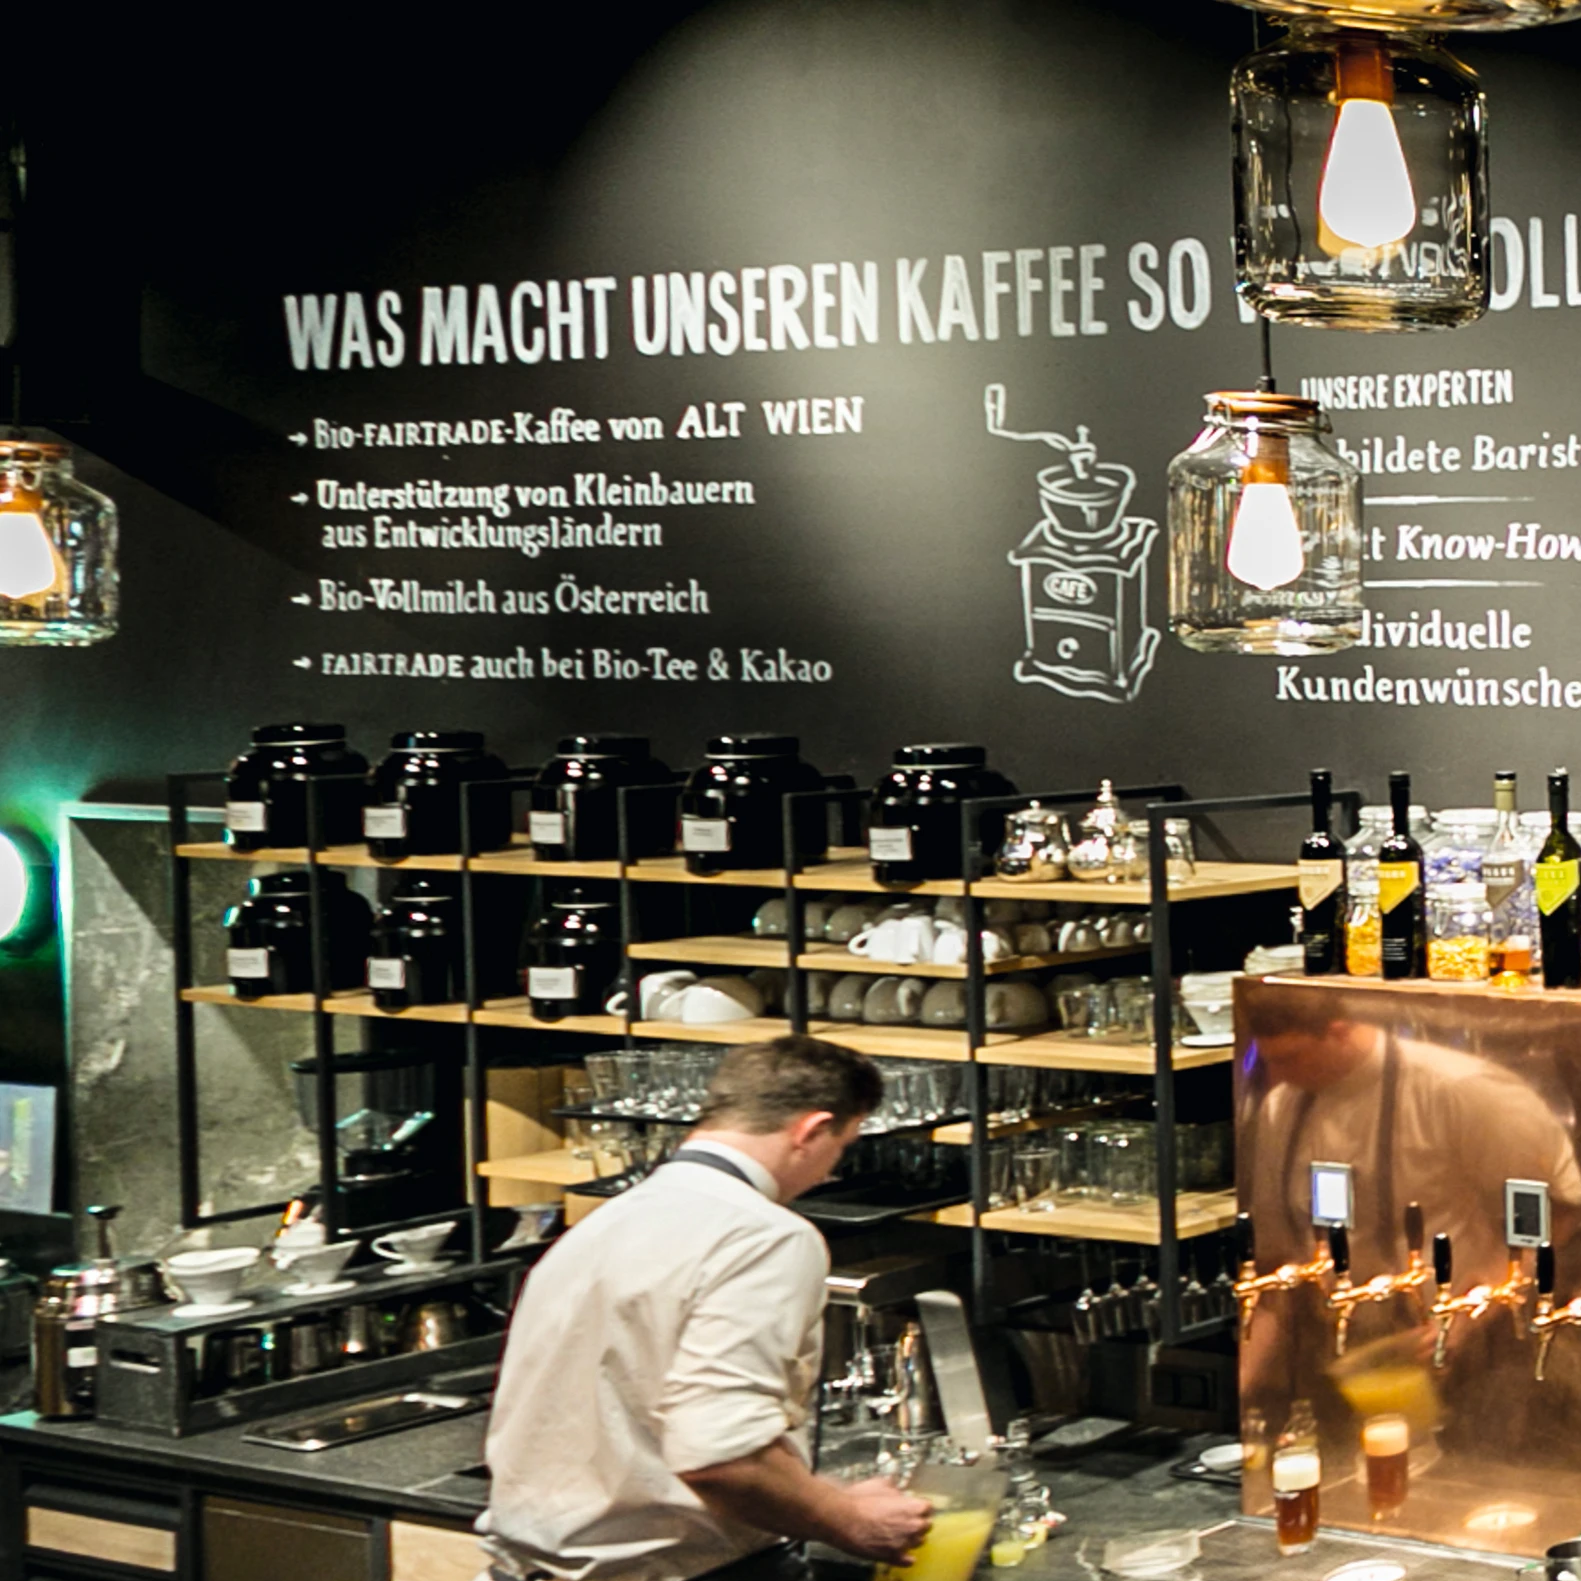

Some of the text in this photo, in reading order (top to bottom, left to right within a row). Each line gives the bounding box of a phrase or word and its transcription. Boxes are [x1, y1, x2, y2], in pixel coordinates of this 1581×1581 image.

[285, 291, 404, 369] WAS
[421, 277, 617, 365] MACHT
[632, 260, 881, 357] UNSEREN
[896, 244, 1107, 343] KAFFEE
[1128, 238, 1211, 330] SO
[1302, 369, 1513, 410] UNSERE EXPERTEN
[608, 418, 663, 440] von
[677, 402, 746, 439] ALT
[762, 396, 865, 434] WIEN
[317, 472, 755, 516] Unterstützung von Kleinbauern
[323, 512, 661, 557] aus Entwicklungsländern
[320, 574, 709, 614] Bio-Vollmilch aus Österreich
[323, 647, 832, 682] FAIRTRADE auch bei Bio-Tee & Kakao
